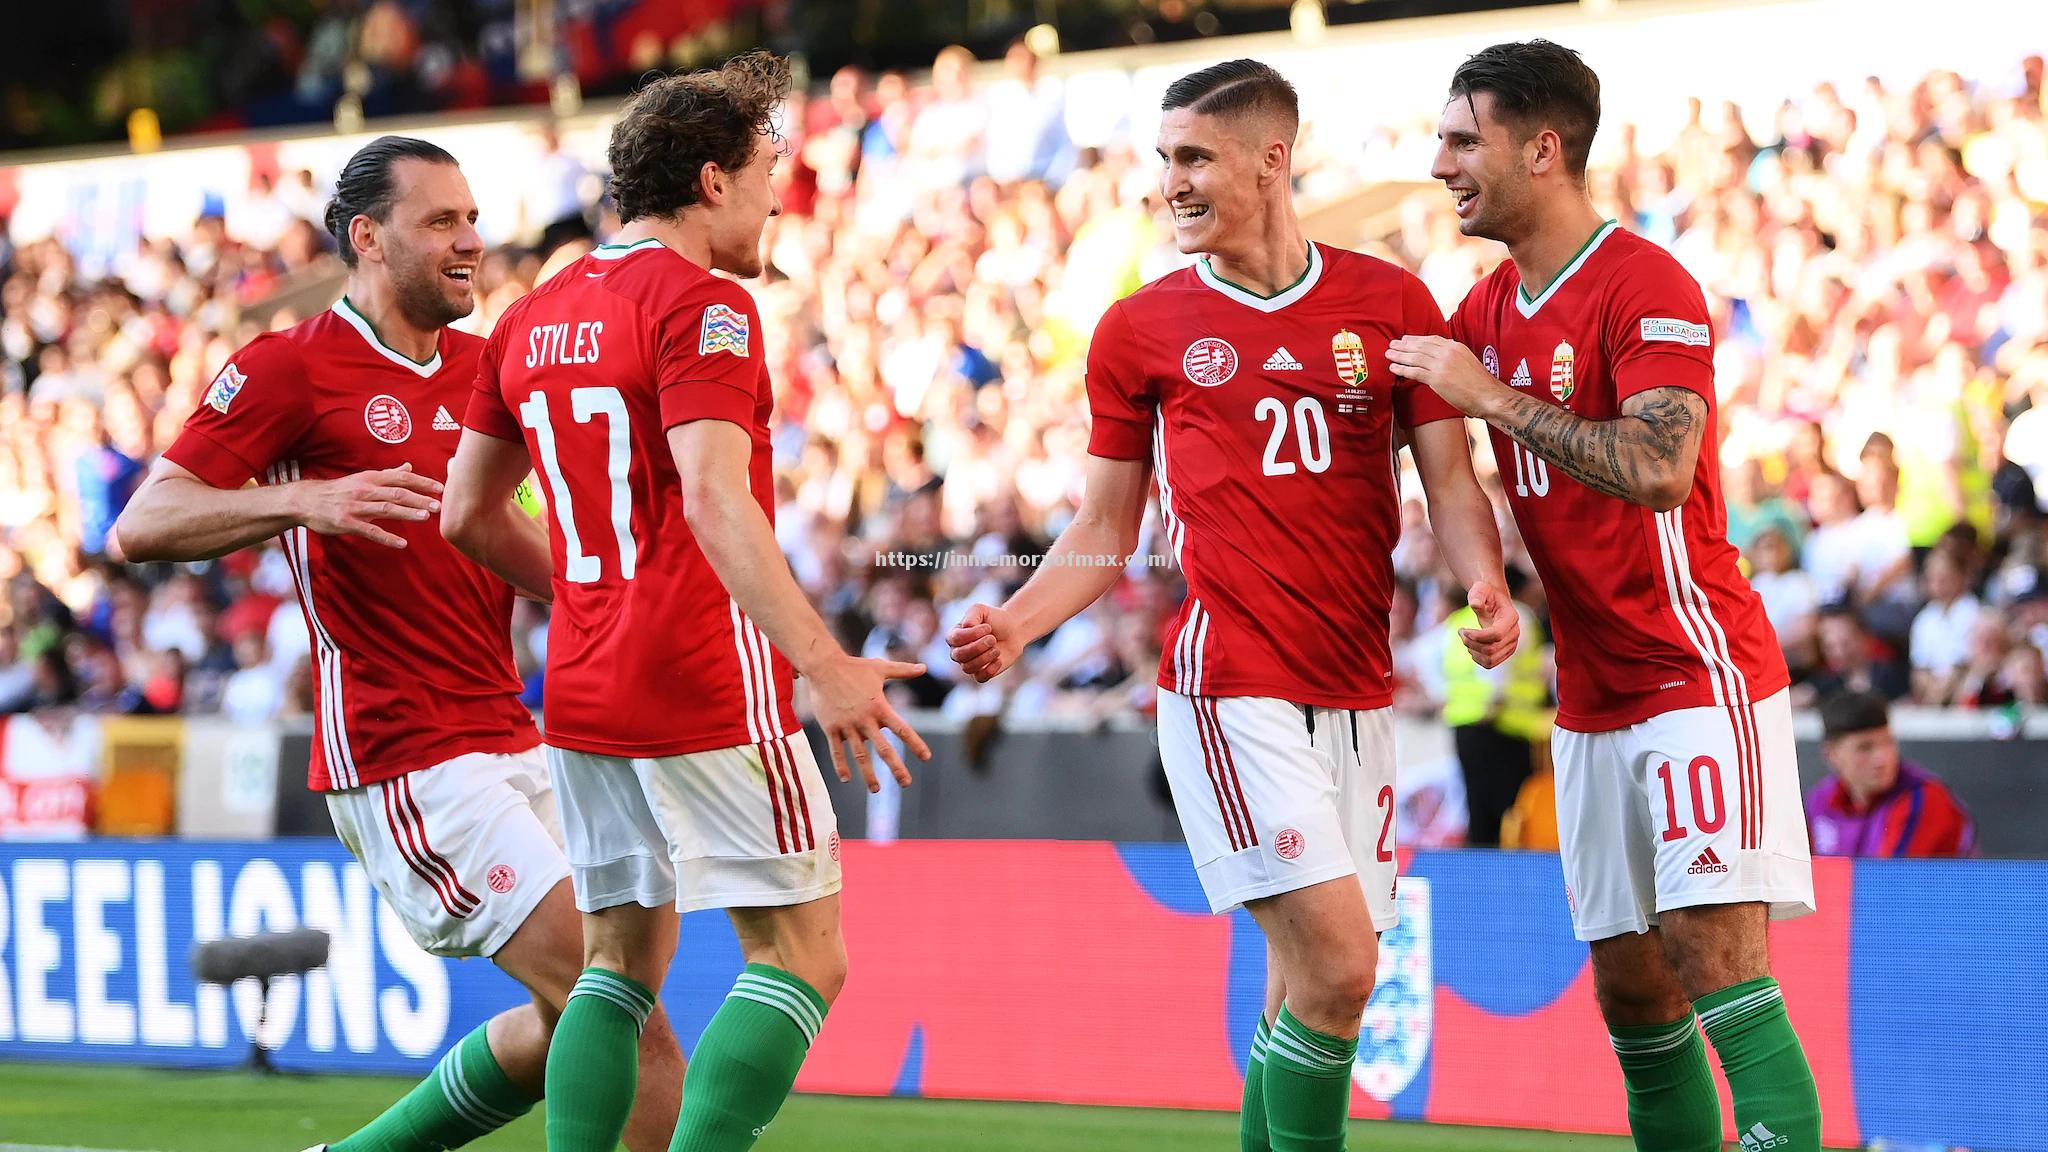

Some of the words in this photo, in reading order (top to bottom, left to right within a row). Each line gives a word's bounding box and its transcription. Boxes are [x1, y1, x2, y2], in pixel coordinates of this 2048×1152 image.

[525, 320, 603, 368] STYLES
[1643, 325, 1707, 338] FOUNDATION
[1262, 361, 1304, 371] adidas
[1509, 376, 1532, 387] adidas
[431, 421, 461, 431] adidas
[1254, 396, 1332, 477] 20
[519, 386, 637, 583] 17
[1658, 755, 1726, 842] 10
[1688, 864, 1728, 875] adidas
[0, 858, 450, 1058] EELIONS
